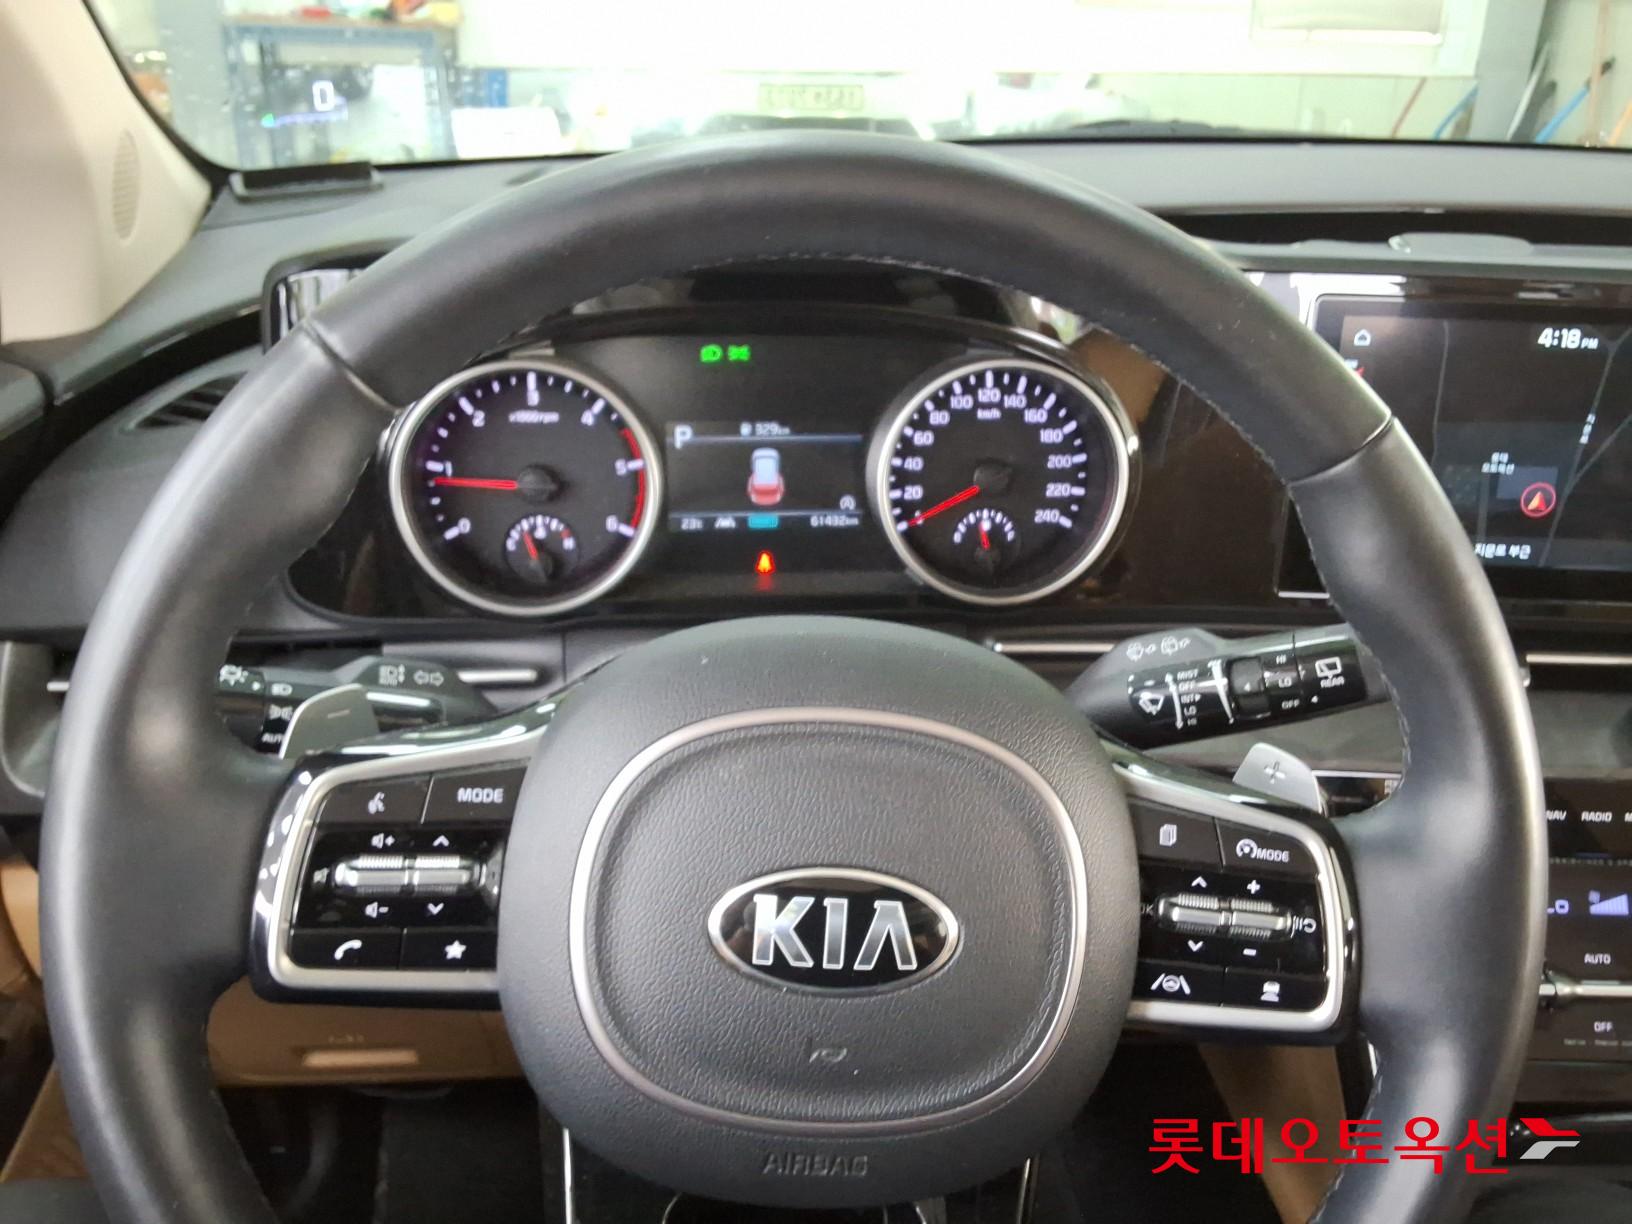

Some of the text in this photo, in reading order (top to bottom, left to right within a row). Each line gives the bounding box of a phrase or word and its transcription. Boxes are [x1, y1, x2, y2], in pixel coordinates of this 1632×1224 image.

[1538, 328, 1599, 349] 4:18 PM
[950, 395, 974, 409] 100
[977, 389, 1001, 403] 120
[1003, 395, 1027, 409] 140
[472, 410, 485, 427] 2
[581, 409, 594, 426] 4
[928, 410, 950, 425] 80
[976, 408, 1001, 420] km/h
[1024, 409, 1048, 424] 160
[674, 424, 693, 449] P
[913, 431, 935, 446] 60
[1039, 429, 1063, 444] 180
[615, 458, 626, 476] 5
[904, 457, 924, 472] 40
[1047, 455, 1073, 469] 200
[903, 485, 923, 500] 20
[1046, 483, 1071, 498] 220
[1034, 509, 1060, 525] 240
[458, 517, 471, 534] 0
[1276, 655, 1287, 664] HI
[1177, 669, 1199, 680] MIST
[1320, 676, 1345, 688] REAR
[457, 787, 504, 804] MODE
[1546, 809, 1567, 821] NAV
[1581, 811, 1613, 823] RADIO
[1256, 846, 1289, 863] MODE
[752, 893, 918, 970] KIA
[1584, 953, 1612, 965] AUTO
[1593, 1021, 1613, 1033] OFF
[762, 1152, 869, 1177] AIRBAG
